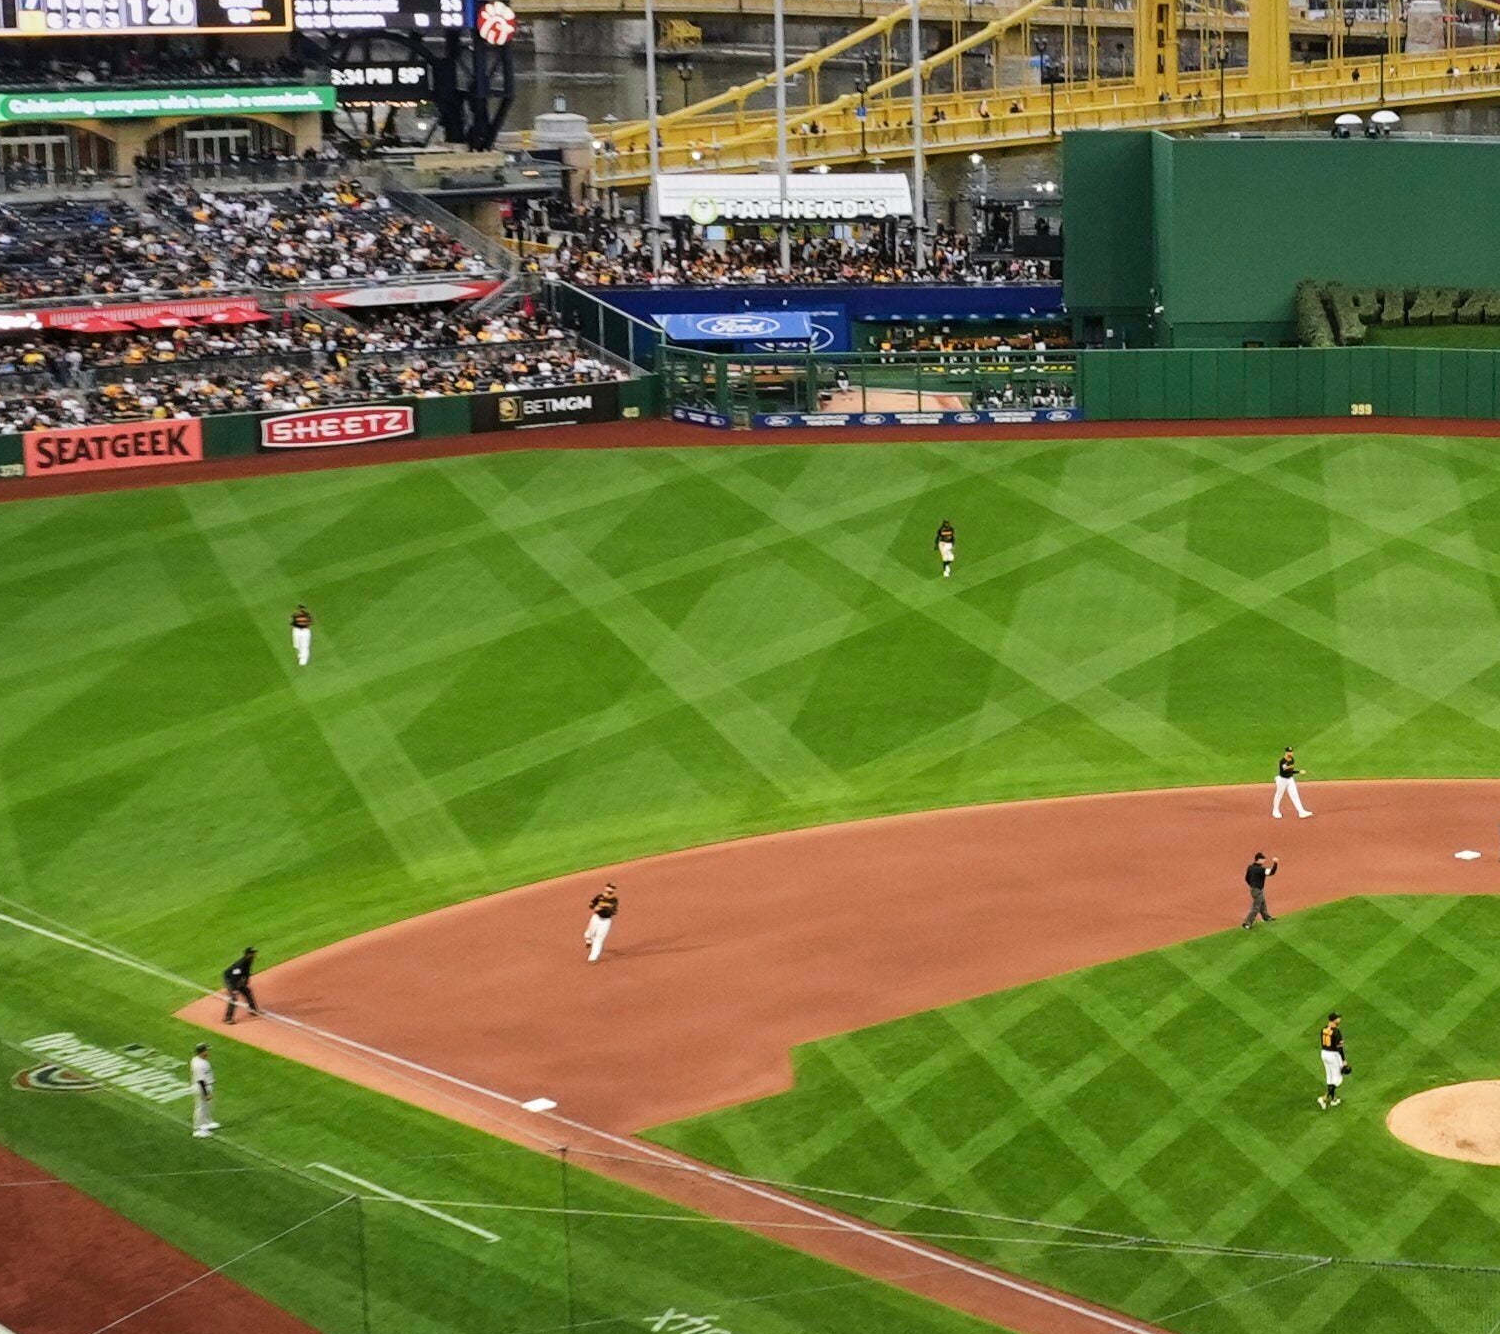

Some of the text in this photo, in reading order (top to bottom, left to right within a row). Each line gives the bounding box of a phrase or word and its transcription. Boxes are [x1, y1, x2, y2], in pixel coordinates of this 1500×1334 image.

[66, 11, 82, 30] 2
[365, 68, 393, 85] PM
[8, 98, 95, 117] Celebrating
[725, 198, 889, 220] FAT HEAD'S
[710, 315, 767, 337] Ford
[523, 395, 593, 416] BETMGM
[1351, 404, 1373, 416] 399
[271, 410, 404, 443] SHEETZ
[35, 424, 192, 470] SEATGEEK
